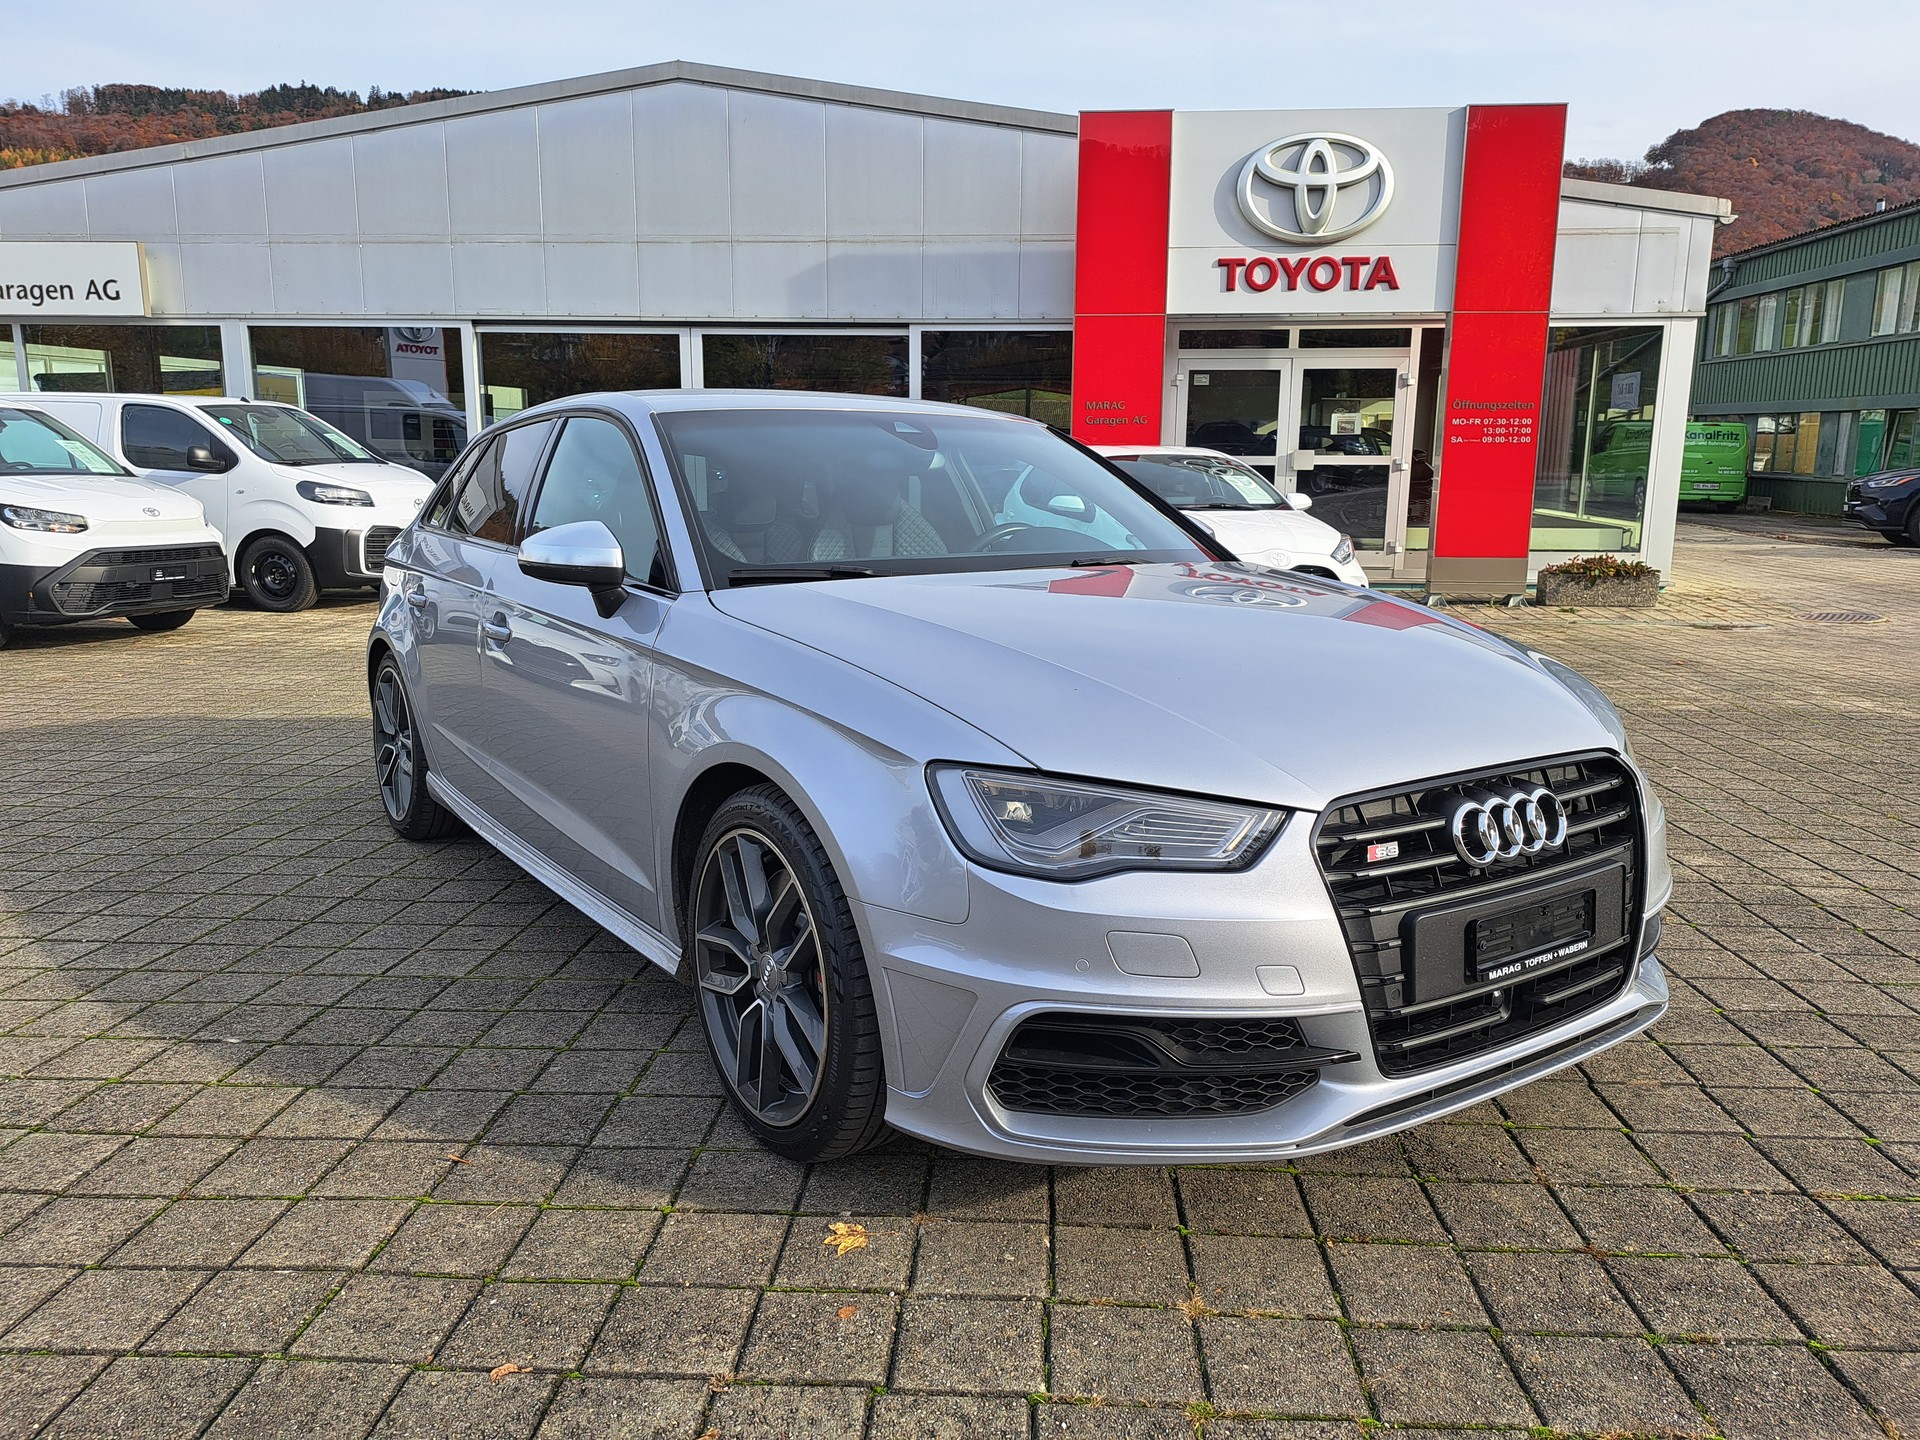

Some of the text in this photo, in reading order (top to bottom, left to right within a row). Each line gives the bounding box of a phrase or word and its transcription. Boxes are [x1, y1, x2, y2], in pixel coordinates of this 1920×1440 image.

[1217, 256, 1400, 292] TOYOTA
[85, 279, 121, 301] AG
[1085, 400, 1126, 410] MARAG
[1452, 398, 1535, 412] Öffnungszeiten
[1085, 415, 1148, 427] Garagen AG
[1483, 417, 1532, 425] 07:30-12:00
[1488, 963, 1522, 980] MARAG
